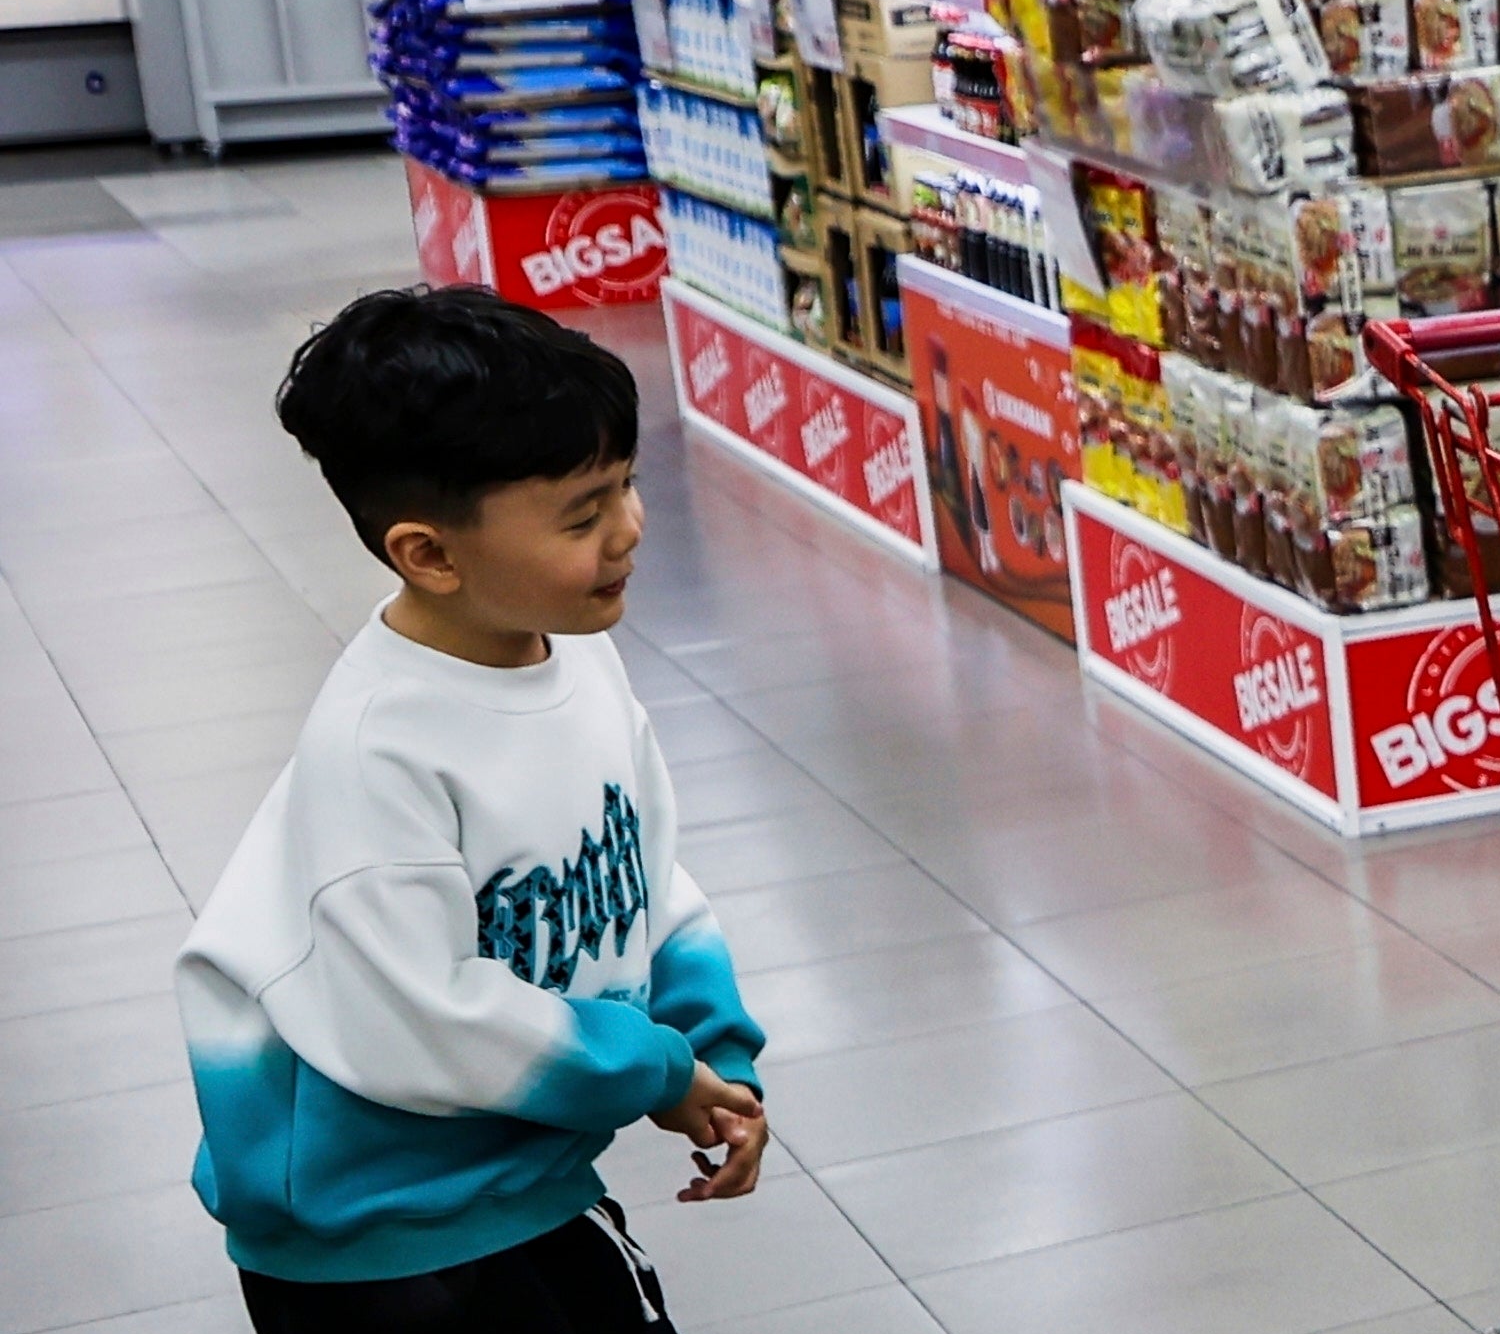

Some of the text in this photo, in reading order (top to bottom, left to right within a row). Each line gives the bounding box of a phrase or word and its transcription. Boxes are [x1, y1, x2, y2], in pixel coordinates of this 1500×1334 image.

[522, 220, 665, 298] BIGSA
[1104, 568, 1182, 653] BIGSALE
[1233, 642, 1320, 733] BIGSALE
